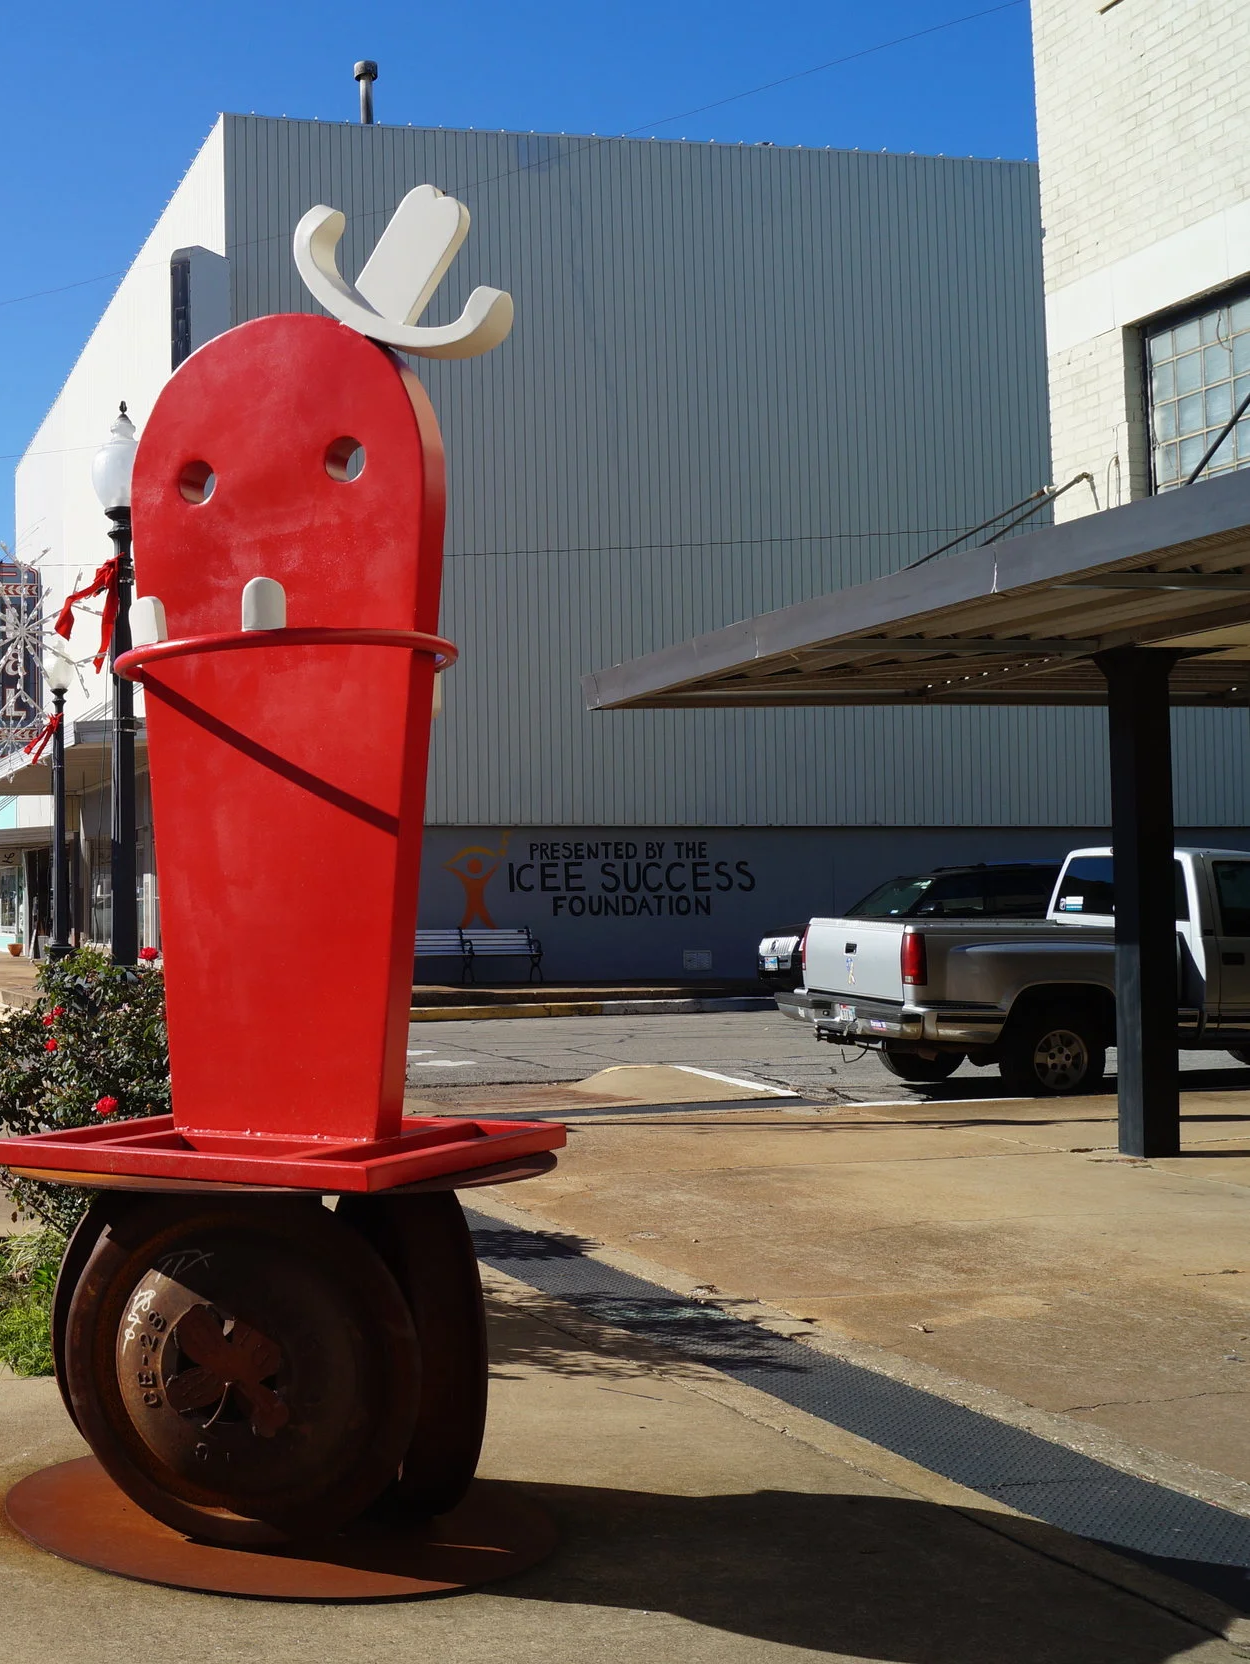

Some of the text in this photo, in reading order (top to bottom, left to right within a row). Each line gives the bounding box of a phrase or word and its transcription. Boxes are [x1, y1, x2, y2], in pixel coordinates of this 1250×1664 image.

[529, 841, 708, 860] PRESENTED BY THE
[508, 861, 756, 893] ICEE SUCCESS
[552, 895, 711, 916] FOUNDATION
